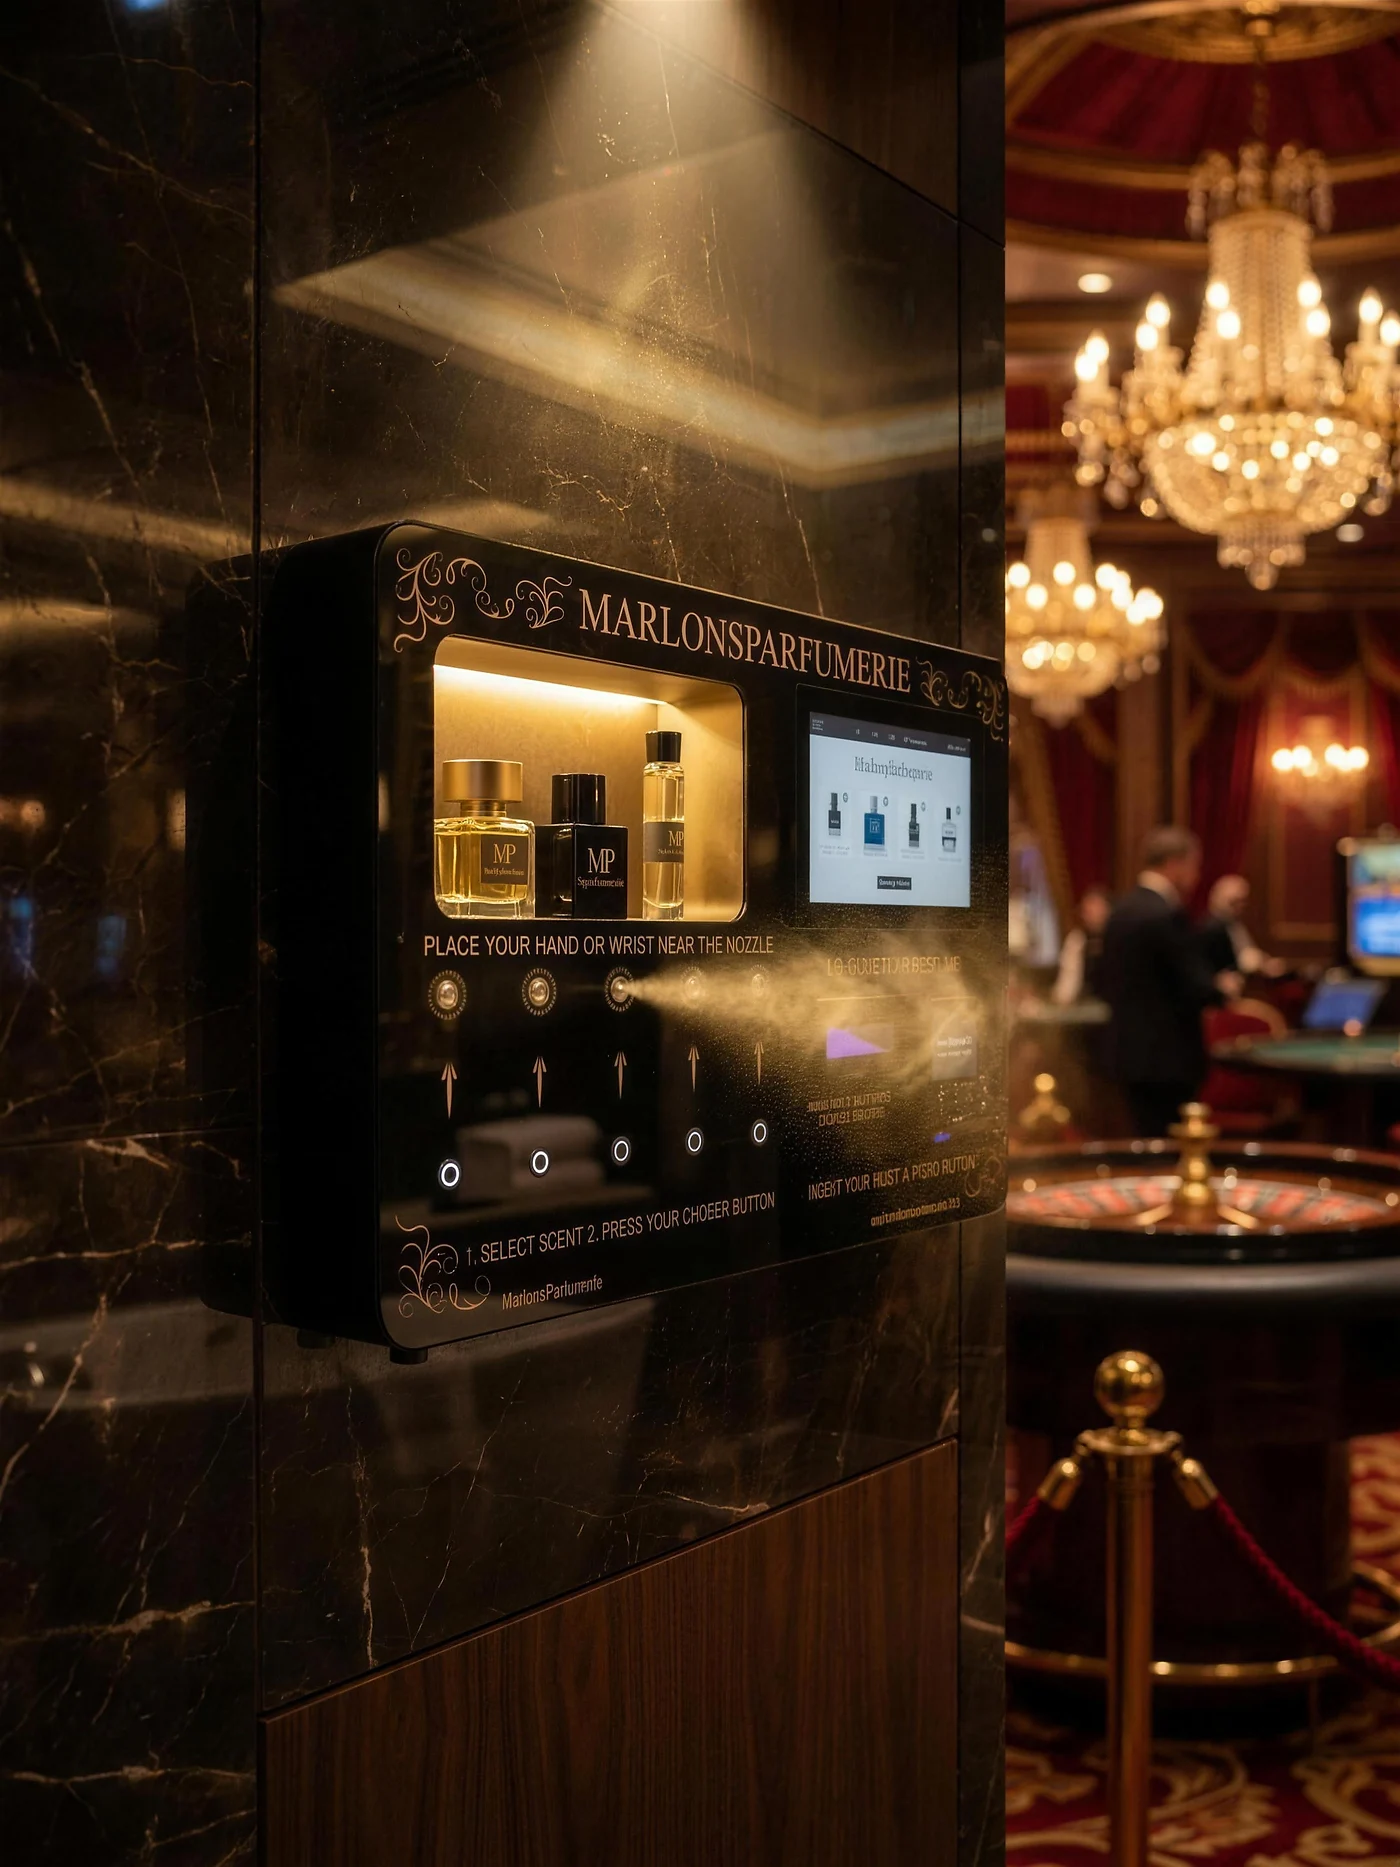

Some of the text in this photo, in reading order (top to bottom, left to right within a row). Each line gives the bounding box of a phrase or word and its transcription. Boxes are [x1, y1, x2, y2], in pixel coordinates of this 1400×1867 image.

[578, 588, 912, 694] MARLONSPARFUMERIE
[668, 830, 685, 846] MP
[493, 843, 516, 864] MP
[587, 847, 615, 874] MP
[424, 935, 774, 957] PLACE YOUR HAND OR WRIST NEAR THE NOZZLE
[844, 1175, 871, 1192] YOUR
[873, 1169, 901, 1187] HUST
[902, 1167, 910, 1182] A
[480, 1235, 535, 1264] SELECT
[539, 1226, 585, 1253] SCENT
[587, 1224, 600, 1244] 2.
[602, 1215, 644, 1242] PRESS
[646, 1209, 680, 1233] YOUR
[732, 1192, 776, 1216] BUTTON
